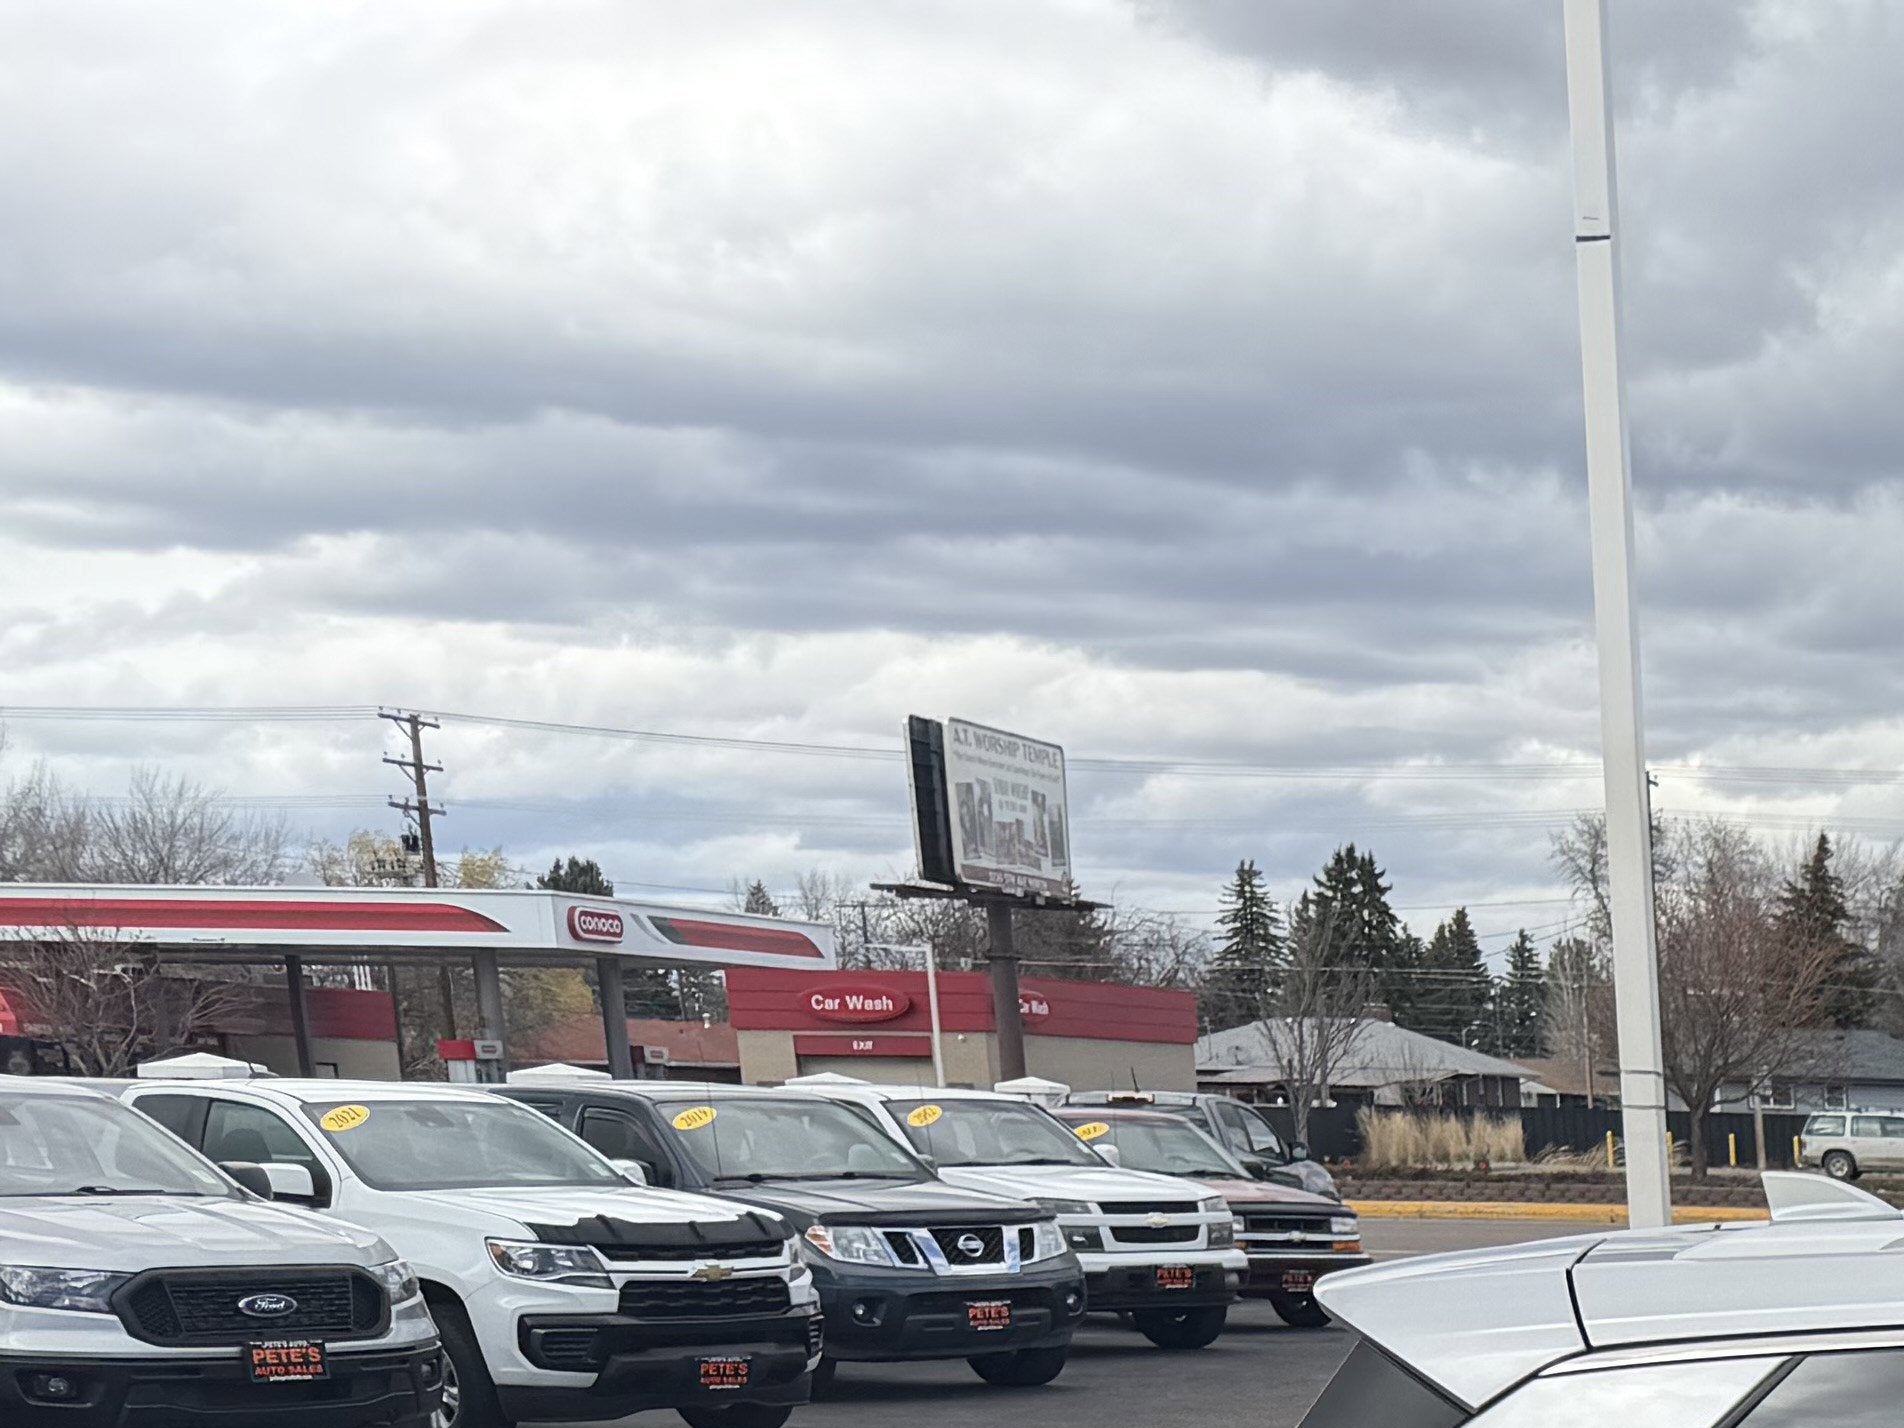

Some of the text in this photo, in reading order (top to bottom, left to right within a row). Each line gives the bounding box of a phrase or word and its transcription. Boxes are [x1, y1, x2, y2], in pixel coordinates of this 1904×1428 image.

[973, 731, 1019, 758] WORSHIP
[1021, 743, 1060, 770] TEMPLE
[811, 995, 894, 1012] Car Wash
[254, 1297, 286, 1312] Ford
[252, 1346, 322, 1364] PETE'S
[255, 1366, 286, 1376] AUTO
[700, 1362, 748, 1375] PETE'S
